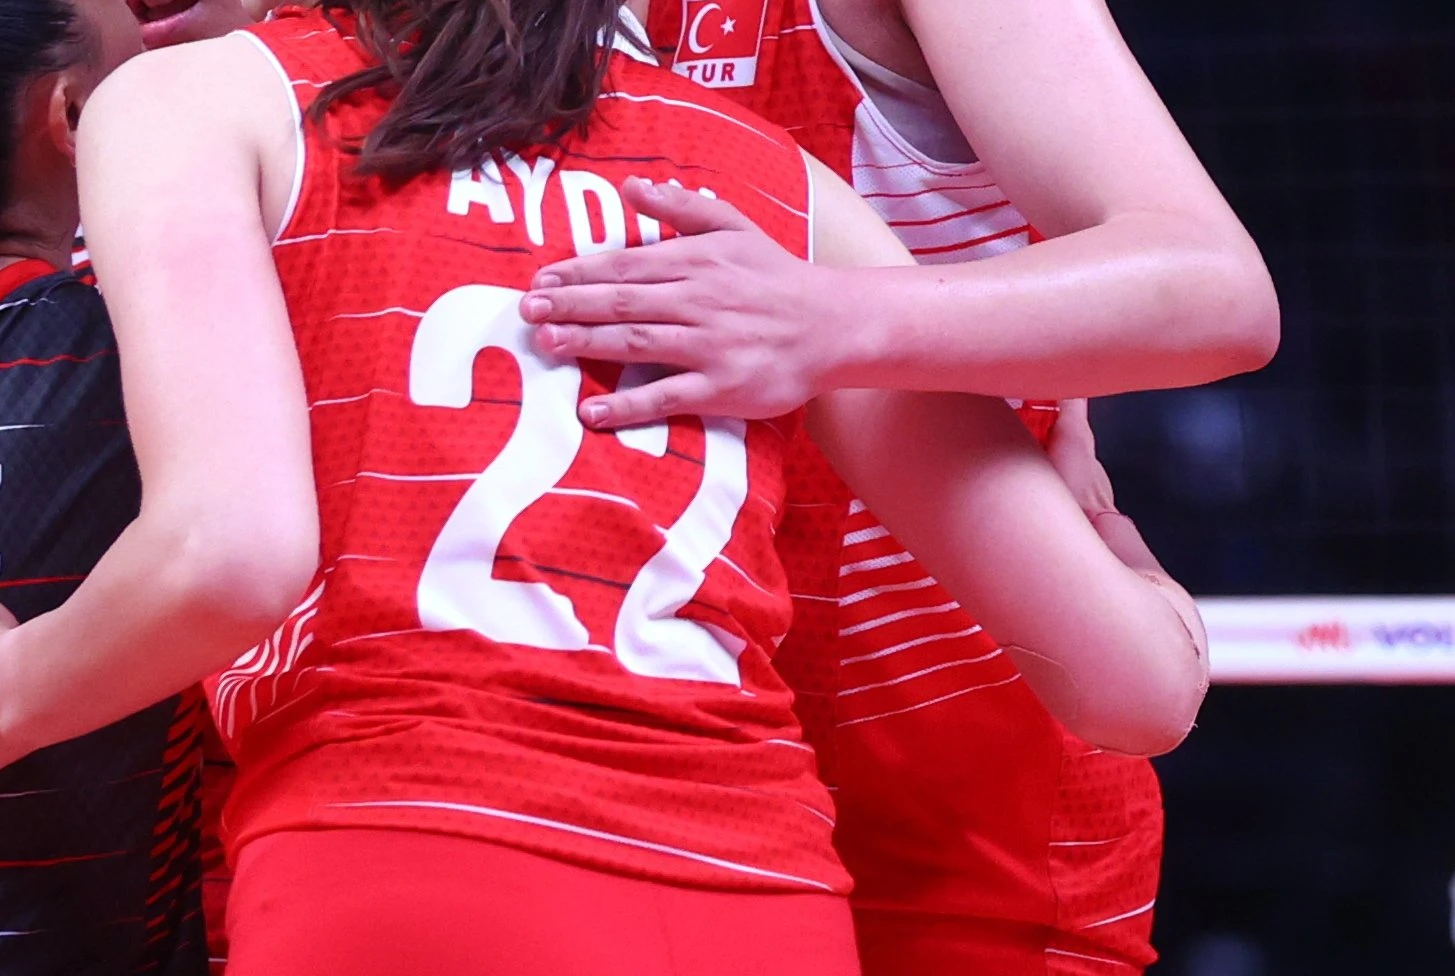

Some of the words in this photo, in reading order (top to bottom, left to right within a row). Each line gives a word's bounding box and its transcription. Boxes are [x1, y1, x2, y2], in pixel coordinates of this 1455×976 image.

[687, 62, 735, 83] TUR
[447, 145, 717, 258] AYD
[409, 284, 748, 689] 22
